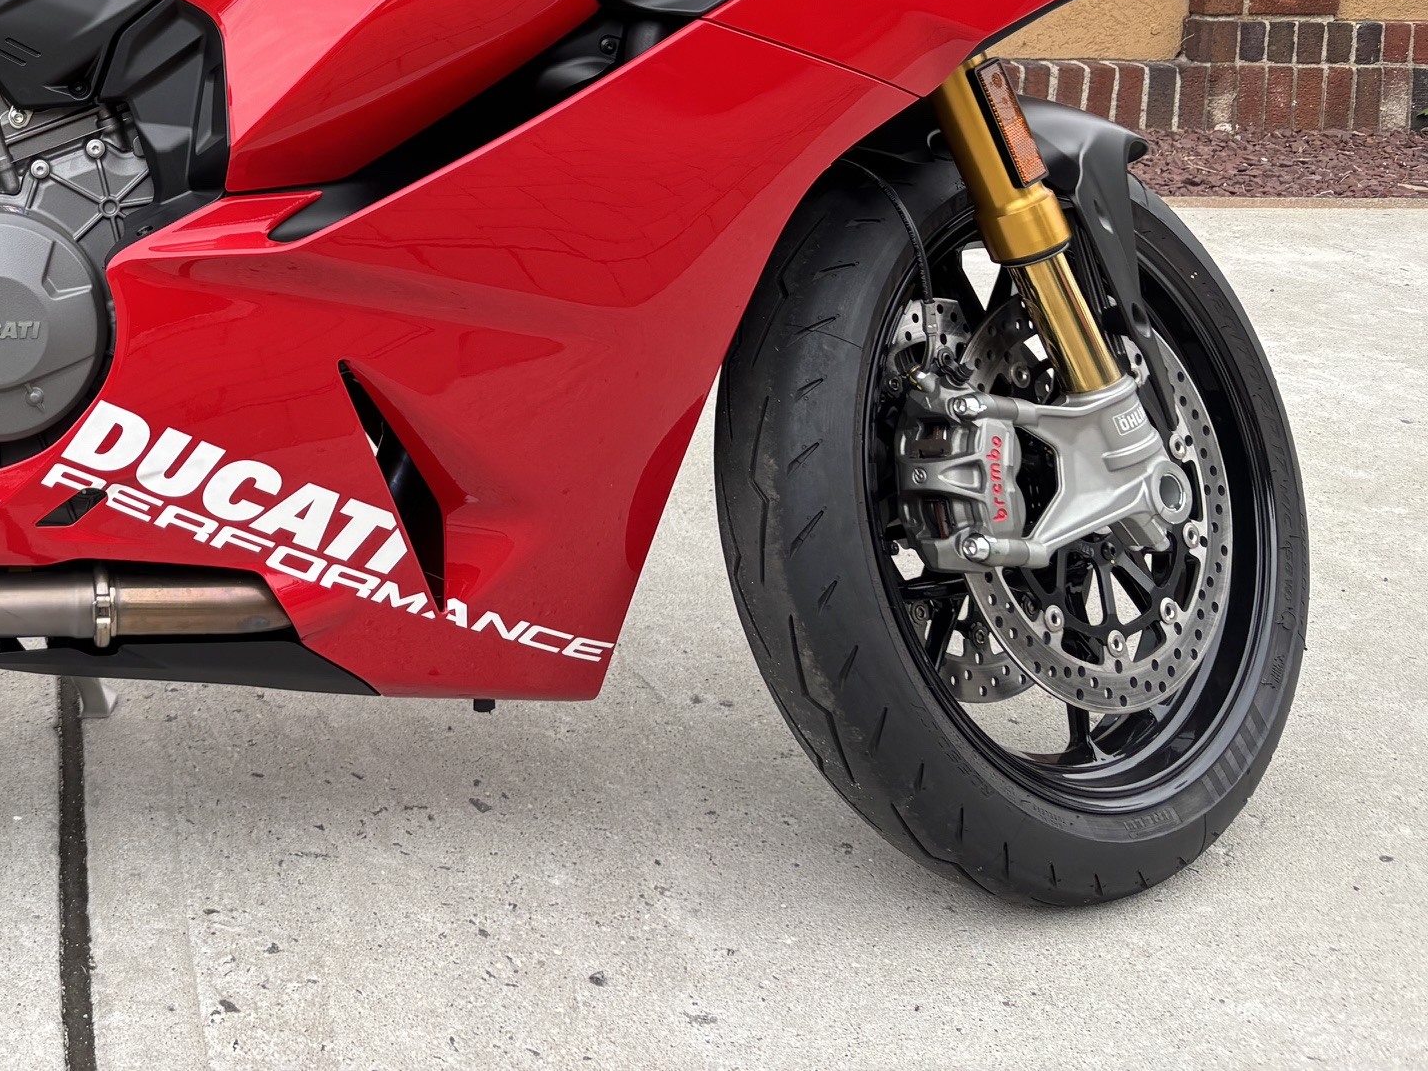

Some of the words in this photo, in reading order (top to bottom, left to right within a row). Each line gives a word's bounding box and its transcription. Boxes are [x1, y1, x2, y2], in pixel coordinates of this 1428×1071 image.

[41, 463, 616, 662] PERFORMANCE
[59, 399, 410, 575] DUCATI
[986, 435, 1008, 522] brembo
